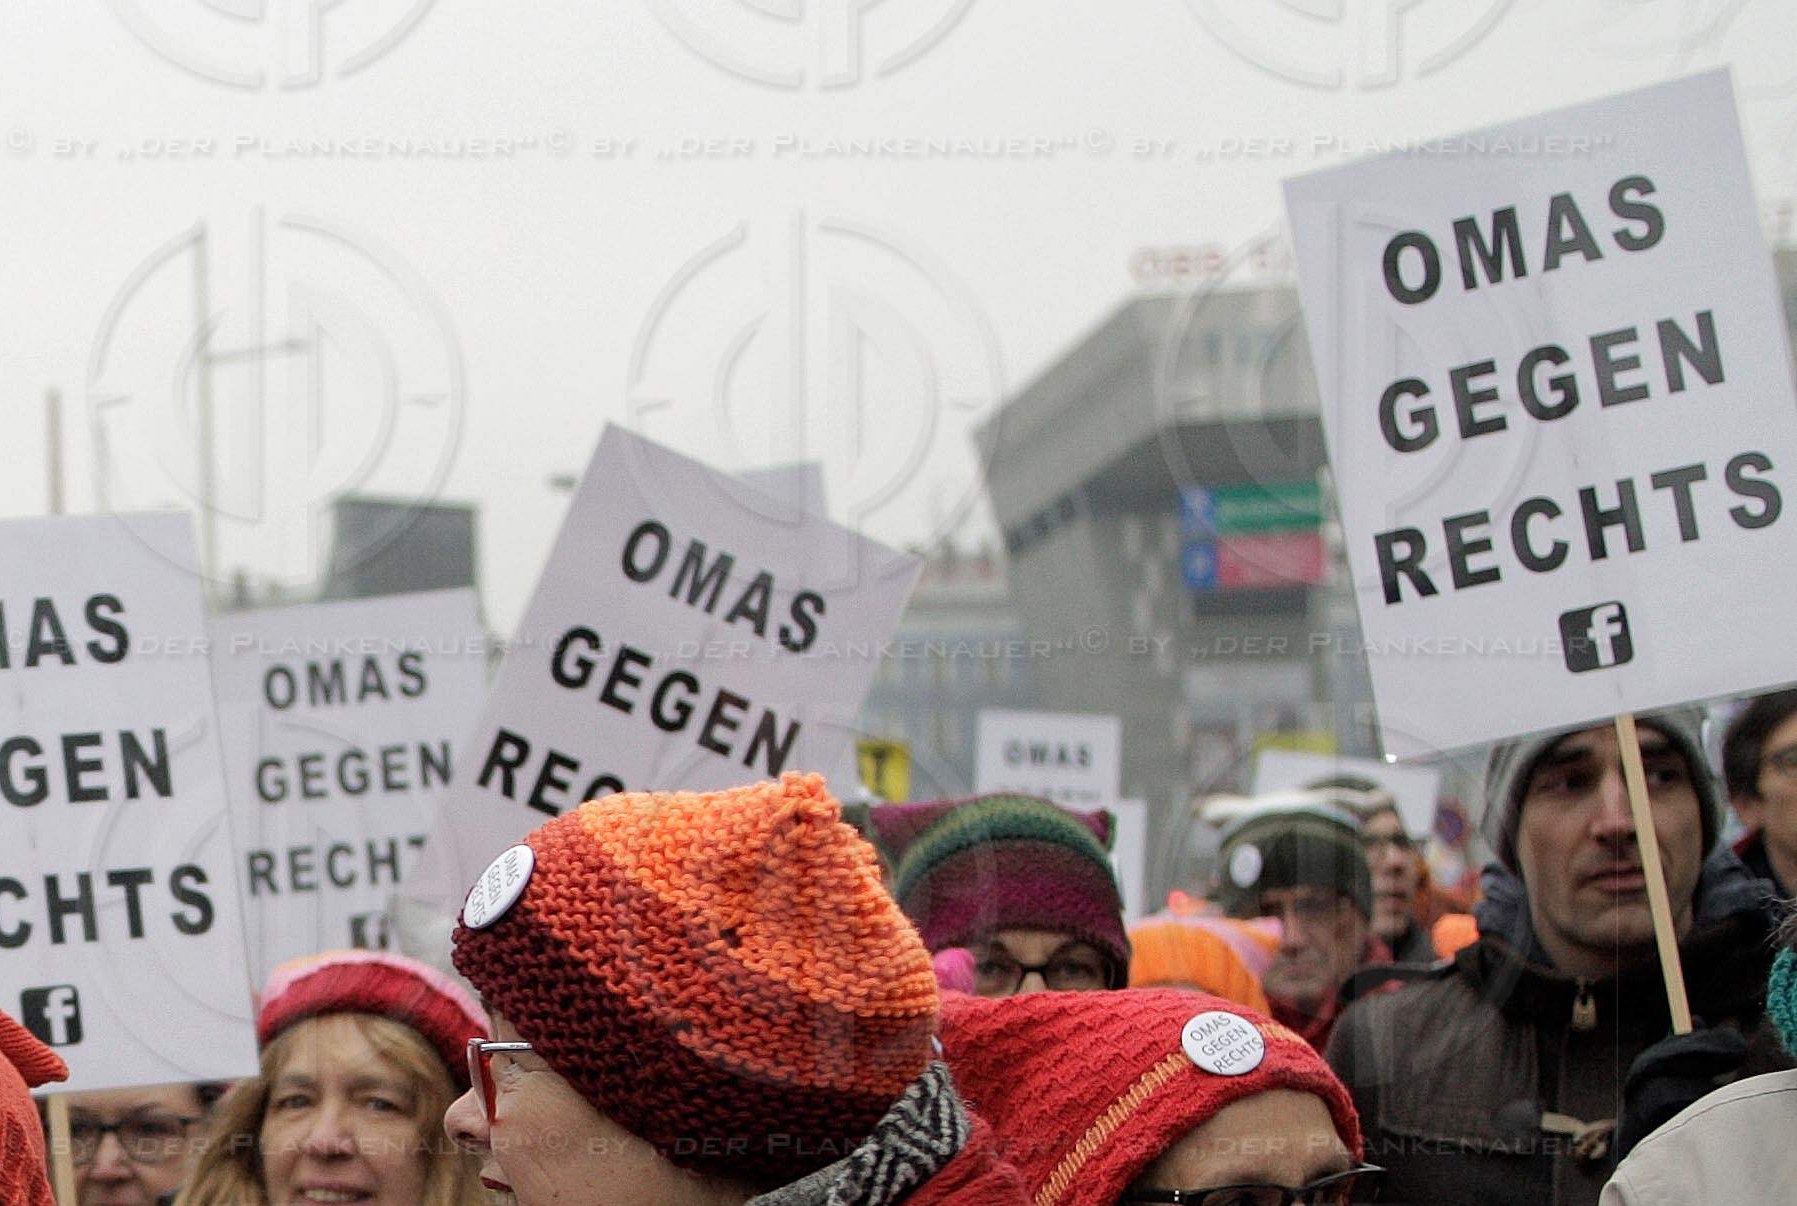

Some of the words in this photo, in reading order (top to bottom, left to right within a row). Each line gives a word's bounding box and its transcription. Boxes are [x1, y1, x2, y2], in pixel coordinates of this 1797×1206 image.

[1383, 177, 1664, 304] OMAS
[1379, 312, 1724, 452] GEGEN
[1375, 452, 1781, 605] RECHTS
[621, 519, 827, 653] OMAS
[265, 651, 426, 709] OMAS
[551, 624, 800, 778] GEGEN
[256, 740, 452, 802] GEGEN
[1004, 740, 1093, 766] OMAS
[1190, 1014, 1231, 1042] OMAS
[1202, 1024, 1248, 1057] GEGEN
[1213, 1036, 1263, 1073] RECHTS
